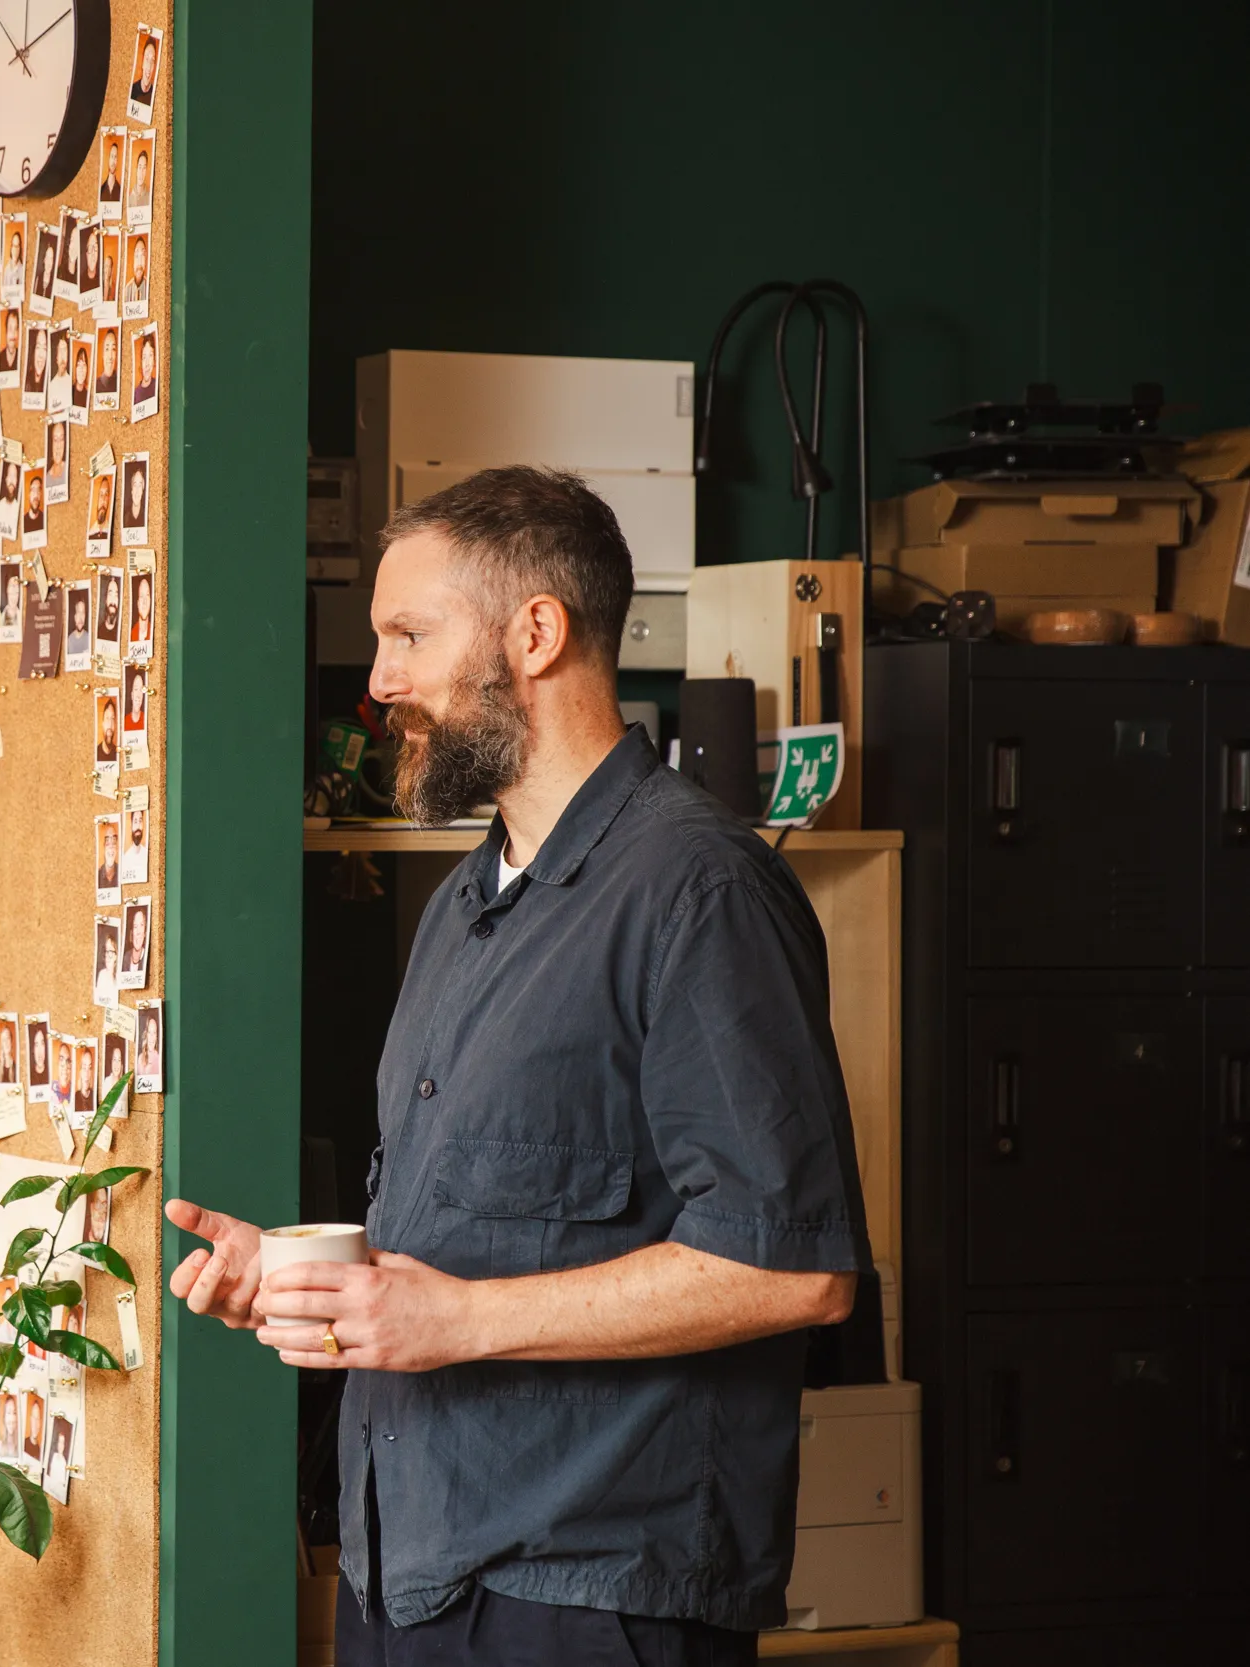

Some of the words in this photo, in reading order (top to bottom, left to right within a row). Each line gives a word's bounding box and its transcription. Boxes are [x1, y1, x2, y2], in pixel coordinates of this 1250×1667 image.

[21, 156, 31, 184] 6
[130, 644, 147, 658] JOHN
[1134, 1043, 1144, 1059] 4
[137, 1077, 152, 1091] Emily
[1135, 1360, 1146, 1375] 7
